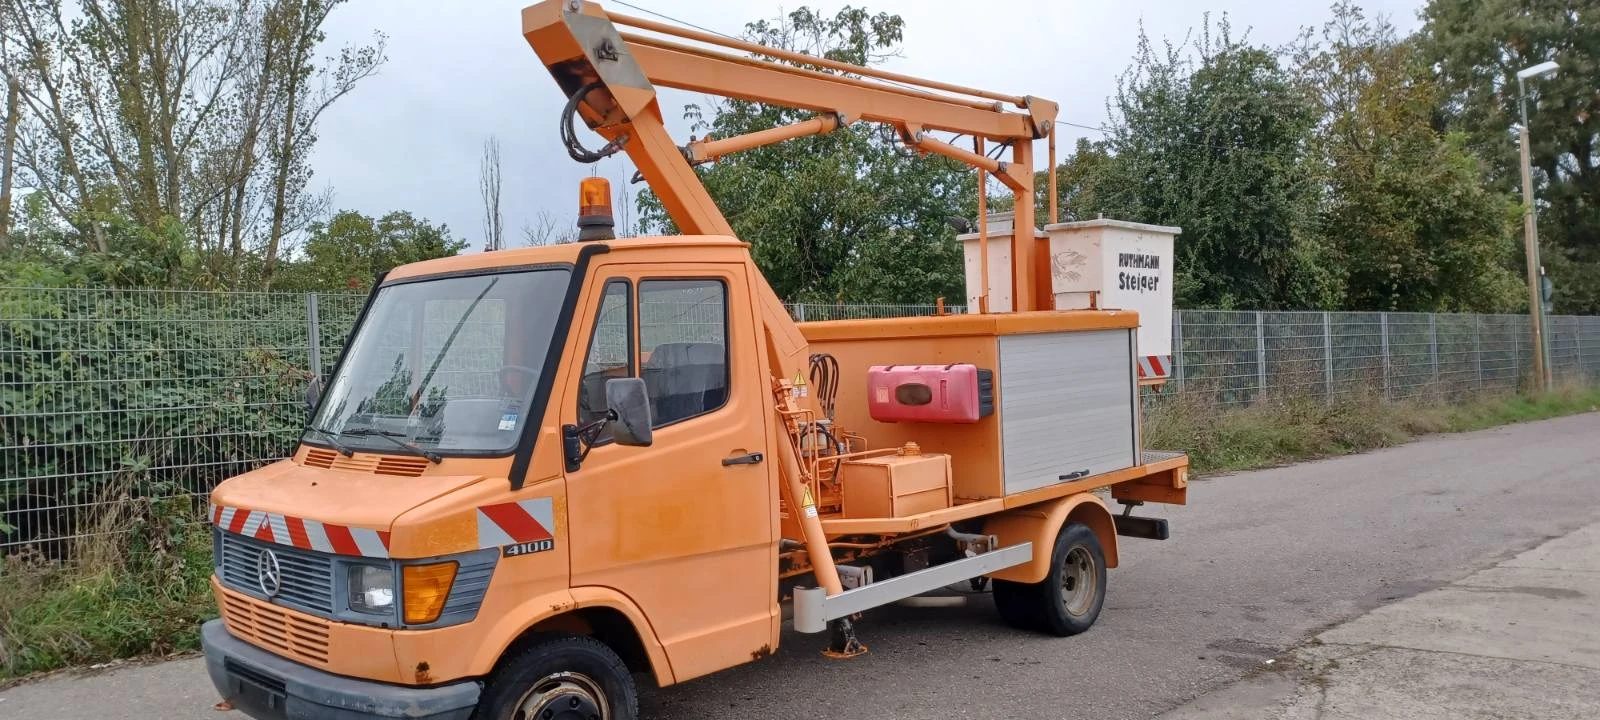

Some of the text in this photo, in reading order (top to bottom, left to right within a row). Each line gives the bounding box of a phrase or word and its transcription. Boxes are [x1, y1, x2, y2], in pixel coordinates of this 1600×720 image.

[1119, 253, 1159, 269] RUTHMANN
[1119, 271, 1159, 294] Steiger
[506, 540, 551, 555] 410D
